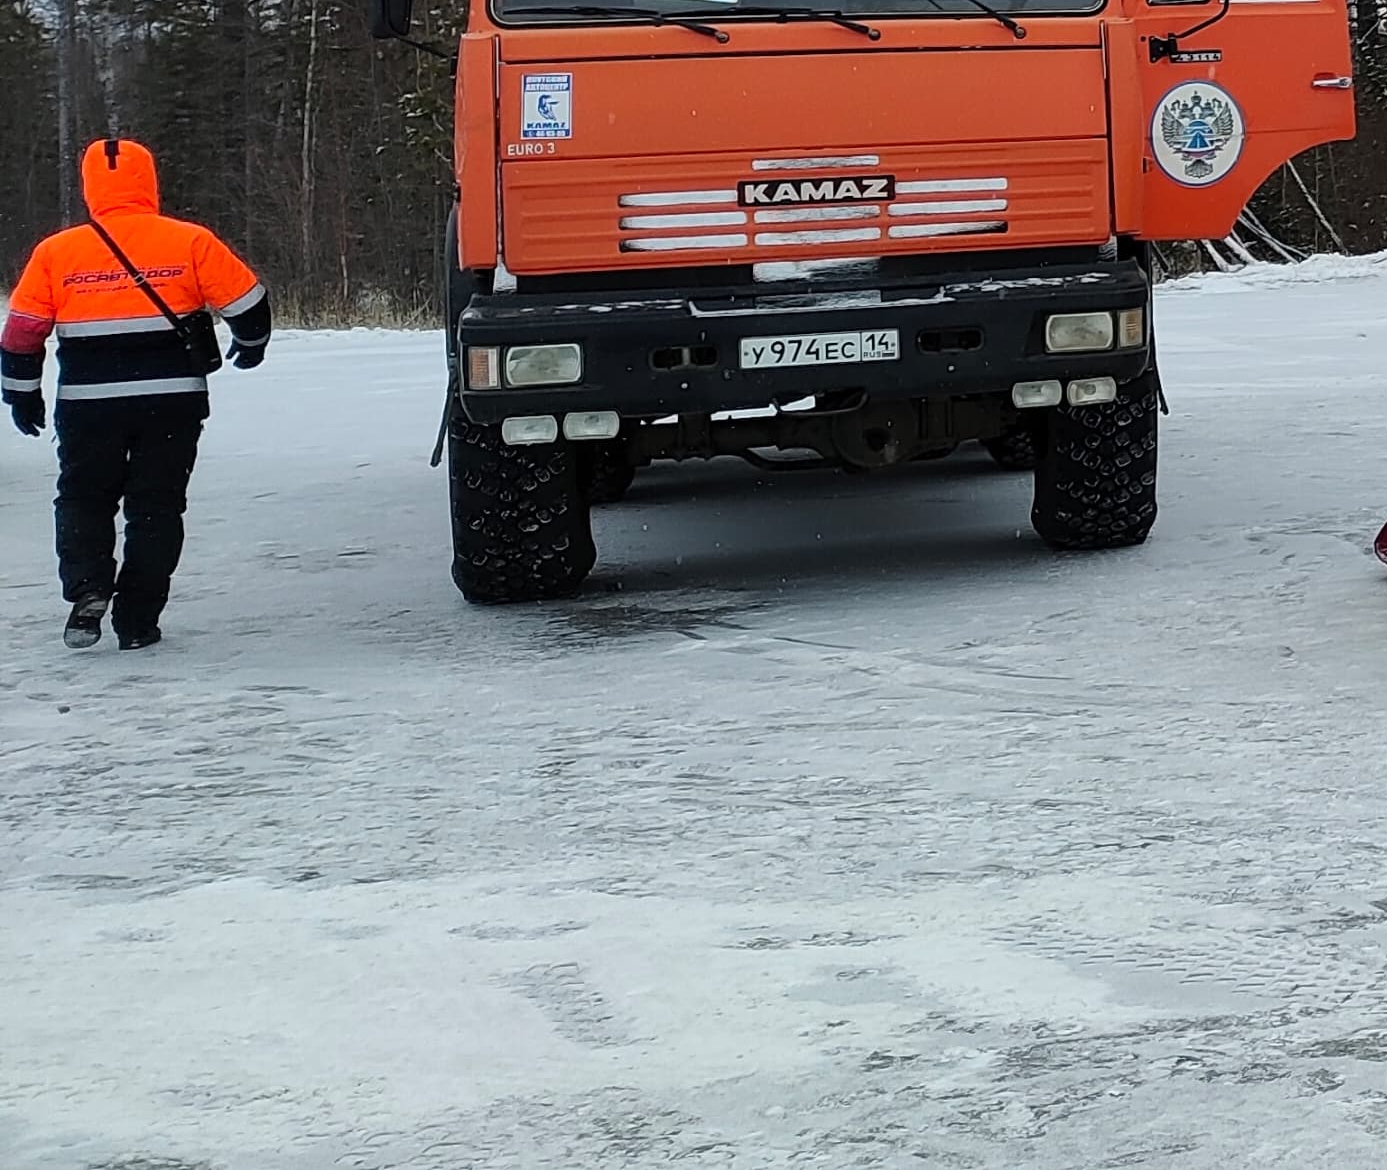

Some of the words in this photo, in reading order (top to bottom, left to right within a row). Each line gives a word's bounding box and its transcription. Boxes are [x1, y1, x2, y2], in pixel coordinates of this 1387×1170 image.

[507, 143, 543, 156] EURO
[547, 142, 555, 154] 3
[744, 179, 888, 204] KAMAZ
[63, 269, 183, 287] РОСАВТДОР
[865, 333, 888, 351] 14
